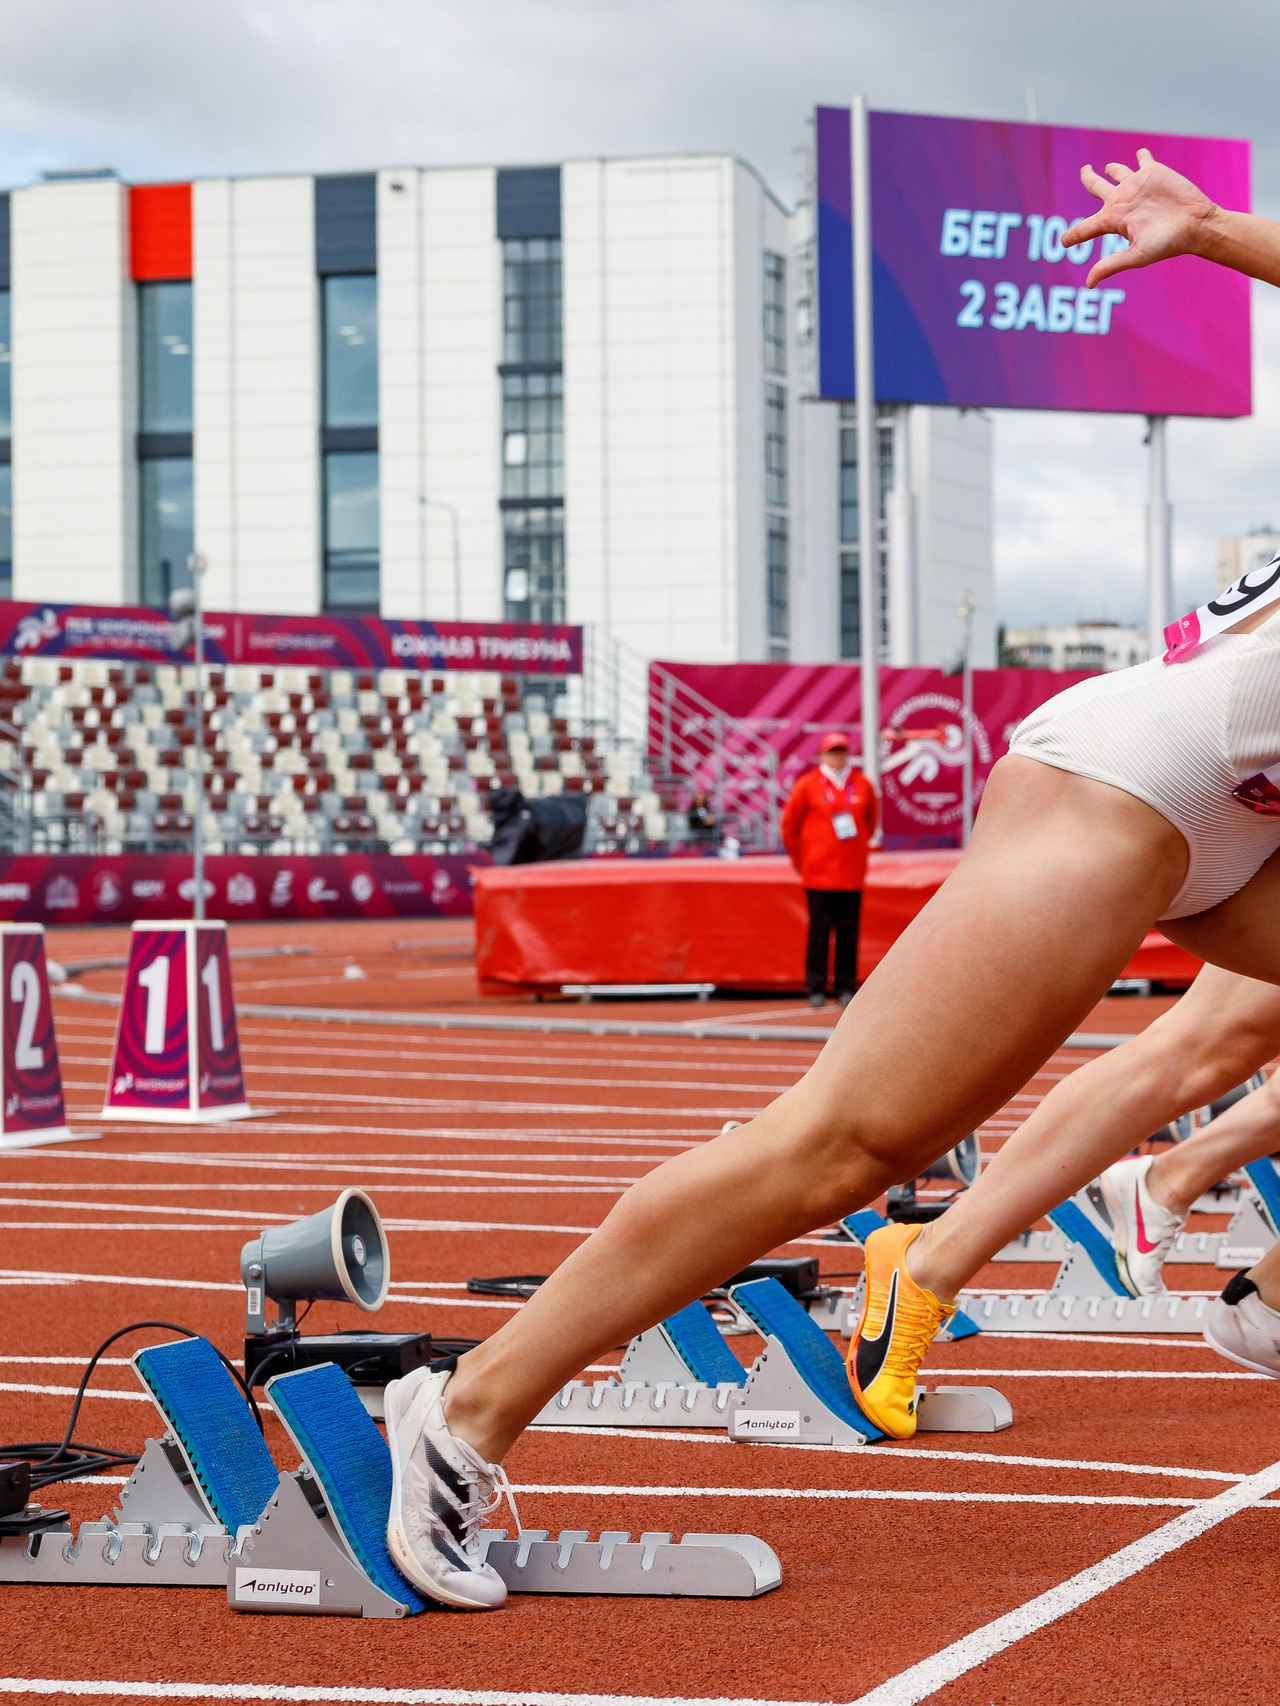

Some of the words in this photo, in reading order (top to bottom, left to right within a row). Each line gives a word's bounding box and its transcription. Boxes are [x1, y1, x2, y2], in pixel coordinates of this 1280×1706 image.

[940, 208, 1022, 259] БЕГ
[1026, 214, 1094, 265] 100
[956, 279, 986, 328] 2
[989, 281, 1126, 335] ЗАБЕГ
[391, 634, 474, 659] ЮЖНАЯ
[478, 636, 573, 662] ТРИБУНА
[10, 960, 45, 1070] 2
[138, 955, 170, 1054] 1
[201, 954, 225, 1052] 1
[751, 1420, 795, 1430] onlytop
[257, 1582, 314, 1595] onlytop
